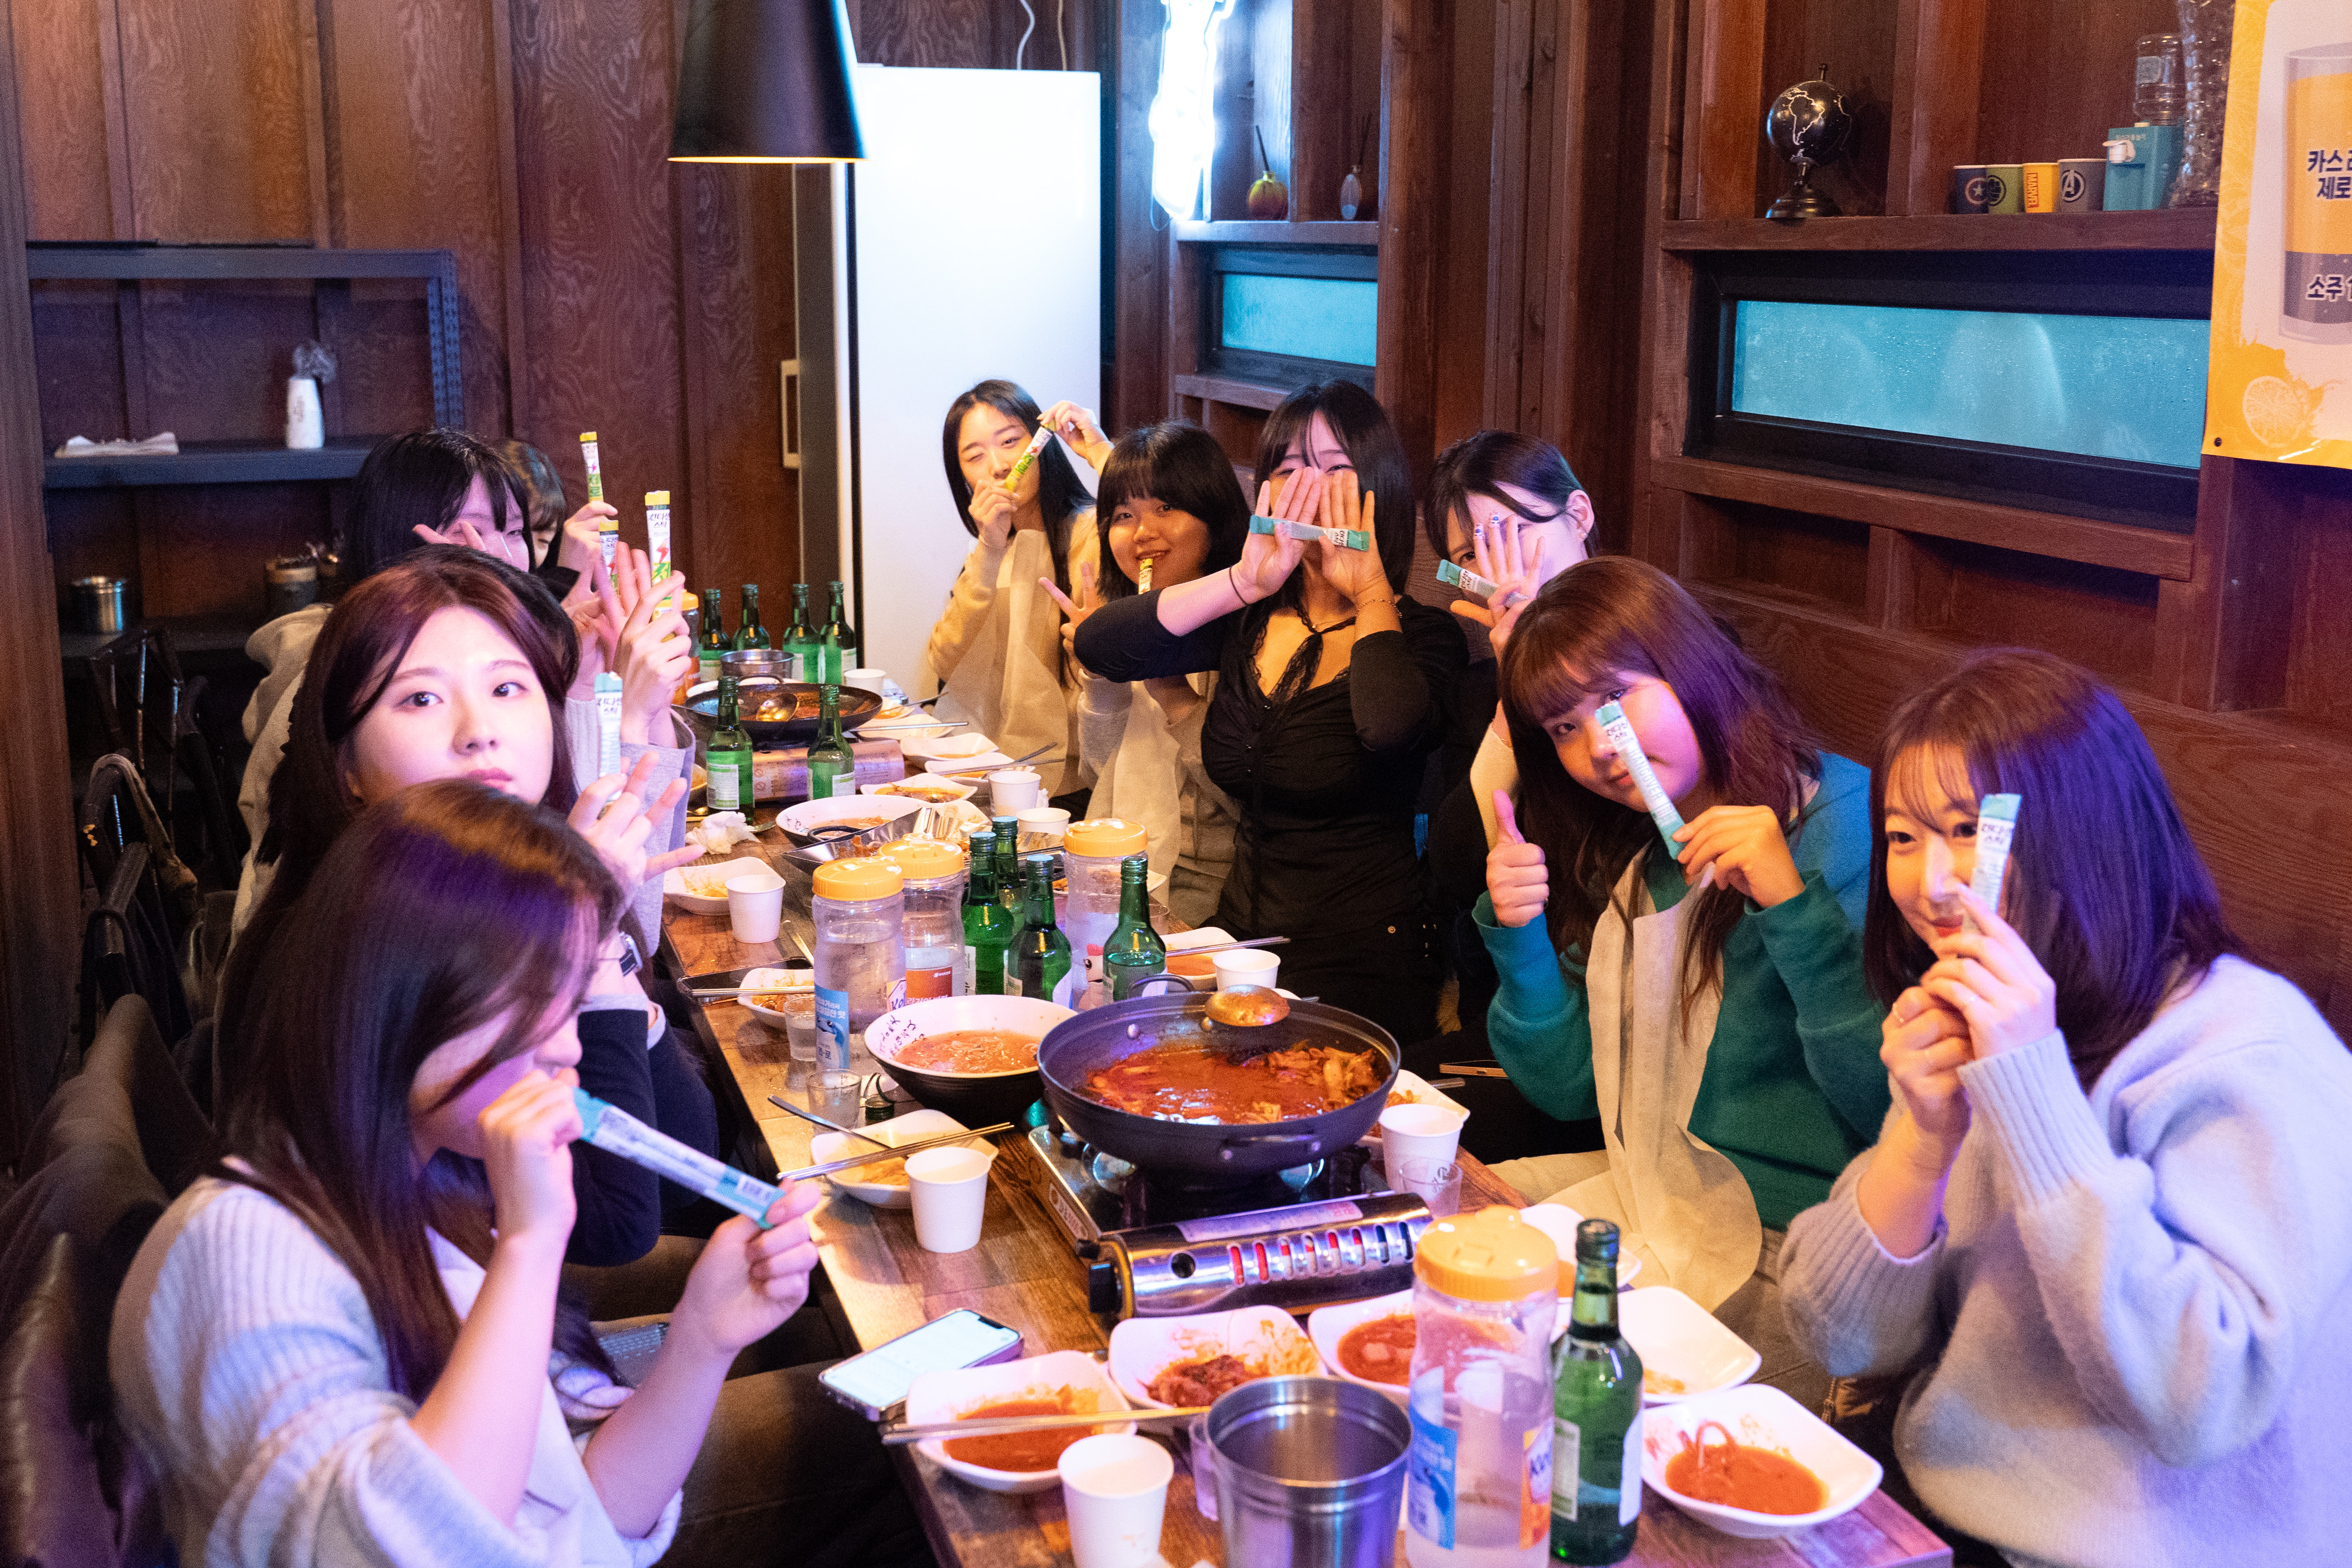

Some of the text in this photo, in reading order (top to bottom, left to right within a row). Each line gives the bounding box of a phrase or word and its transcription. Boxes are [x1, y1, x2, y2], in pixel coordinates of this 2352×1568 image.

[2308, 150, 2343, 173] 카스
[2317, 176, 2351, 199] 제로
[2307, 276, 2342, 299] 소주
